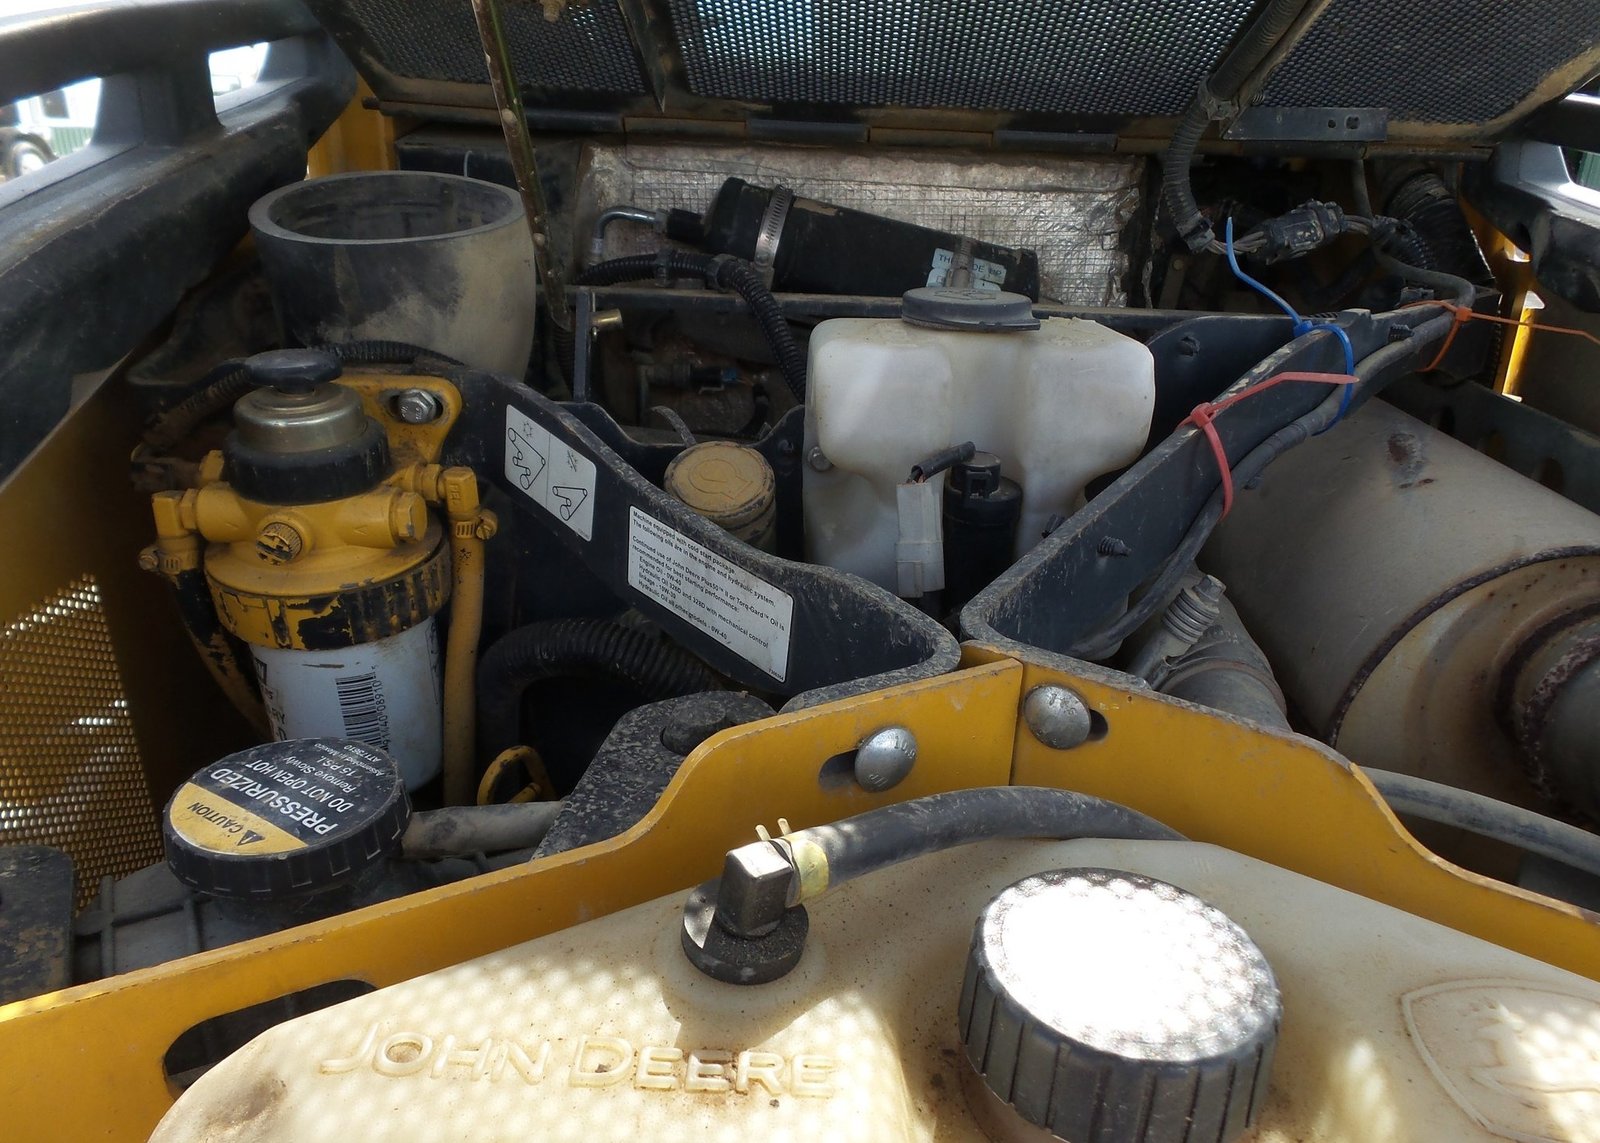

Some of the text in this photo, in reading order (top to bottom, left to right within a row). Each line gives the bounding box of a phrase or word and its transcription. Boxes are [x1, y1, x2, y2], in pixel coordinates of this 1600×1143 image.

[633, 510, 736, 576] Machine equipped with cold start package.
[633, 518, 641, 528] The
[642, 524, 663, 542] following
[664, 537, 673, 547] oils
[682, 547, 688, 555] in
[689, 551, 697, 561] the
[698, 558, 715, 573] engine
[716, 568, 726, 578] and
[727, 574, 752, 595] hydraulic
[754, 590, 775, 608] system.
[639, 555, 654, 571] Engine
[632, 544, 664, 567] recommended
[673, 568, 683, 579] best
[684, 575, 703, 592] starting
[632, 534, 655, 553] Continued
[657, 550, 665, 559] use
[672, 558, 684, 571] John
[685, 566, 700, 580] Deere
[729, 593, 734, 601] or
[770, 617, 778, 627] Oil
[779, 622, 784, 631] is
[639, 572, 654, 587] linkage
[638, 579, 659, 598] Hydraulic
[675, 602, 687, 615] other
[639, 563, 660, 582] Hydraulic
[682, 590, 691, 600] and
[706, 605, 716, 616] with
[717, 612, 747, 636] mechanical
[748, 631, 768, 649] control
[314, 743, 340, 758] Mexico
[346, 757, 384, 776] Assembled
[245, 759, 354, 813] DO NOT OPEN HOT
[282, 756, 356, 793] Remove Slowly
[339, 767, 356, 777] 15
[187, 802, 244, 834] CAUTION
[210, 768, 339, 835] PRESSURIZED
[319, 1022, 835, 1100] JOHN DEERE
